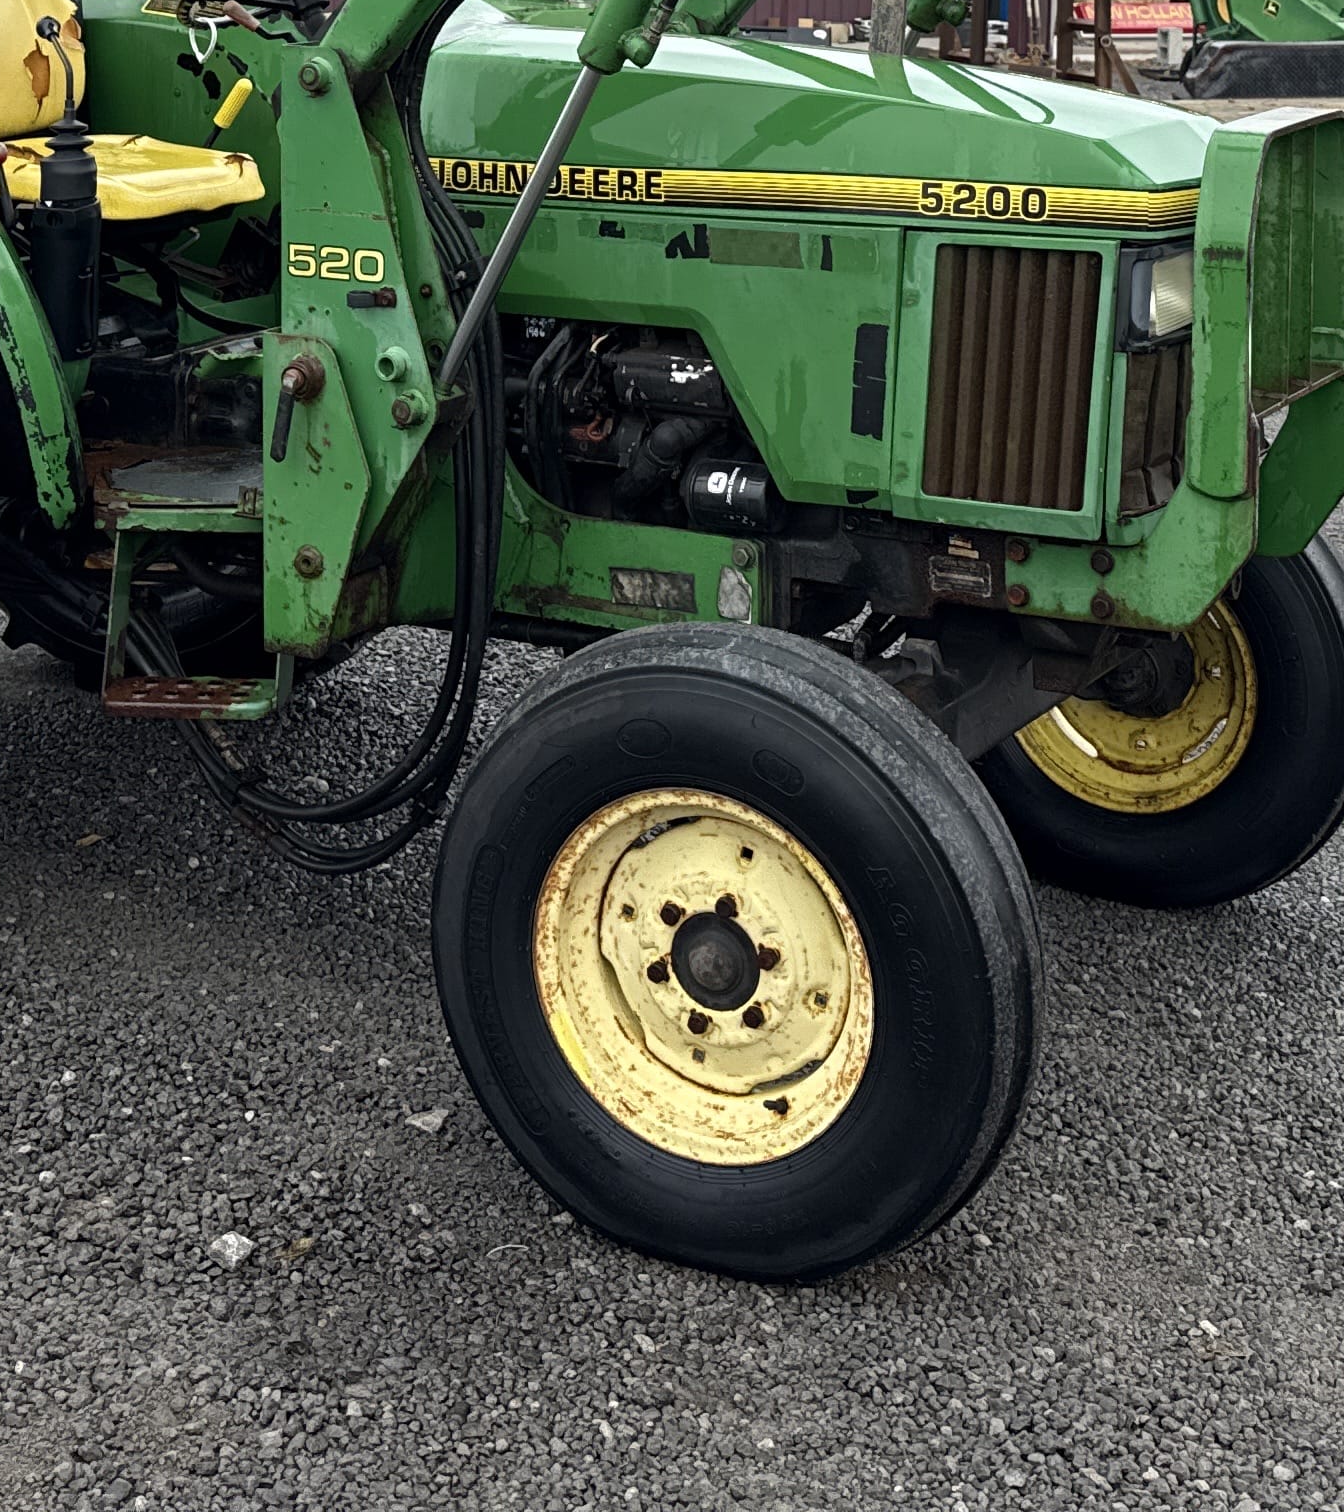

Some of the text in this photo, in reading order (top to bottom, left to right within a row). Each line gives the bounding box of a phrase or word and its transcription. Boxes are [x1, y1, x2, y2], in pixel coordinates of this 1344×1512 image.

[1126, 5, 1192, 19] HOLLAN
[919, 181, 1049, 222] 5200
[288, 242, 385, 283] 520
